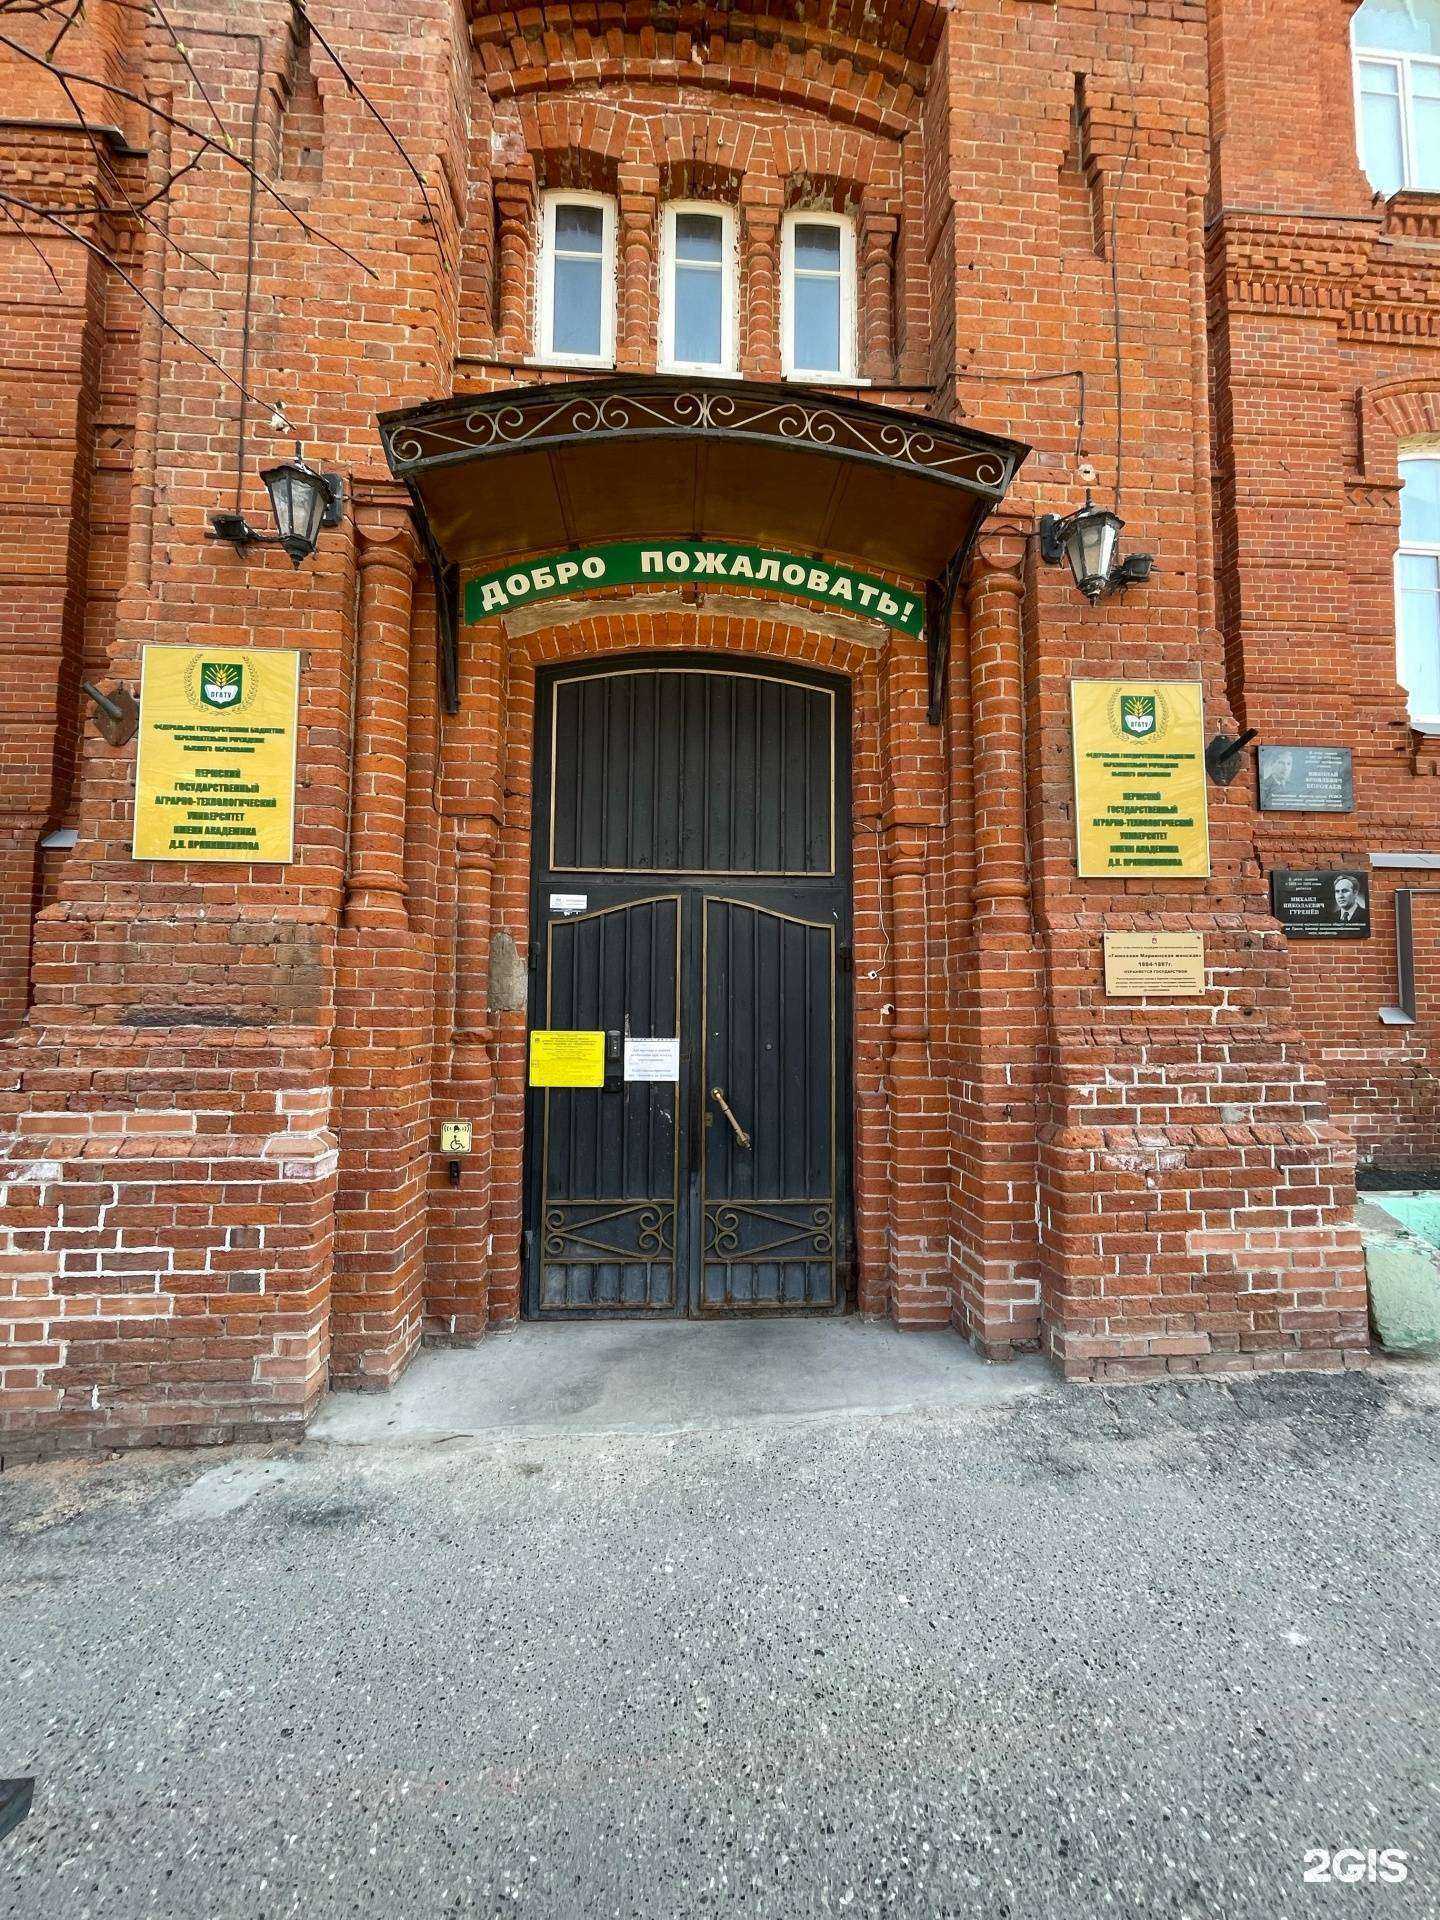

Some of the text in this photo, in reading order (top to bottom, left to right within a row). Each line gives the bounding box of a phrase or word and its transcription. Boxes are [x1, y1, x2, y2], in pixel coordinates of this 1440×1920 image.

[480, 551, 916, 623] ДОБРО ПОЖАЛОВАТЬ!
[195, 768, 240, 778] ПЕРМСКИЙ
[174, 782, 259, 793] ГОСУДАРСТВЕННЫЙ
[155, 796, 276, 807] АГРАРНО-ТЕХНОЛОГИЧЕСКИЙ
[187, 811, 245, 821] УНИВЕРСИТЕТ
[204, 826, 256, 836] АКАДЕМИКА
